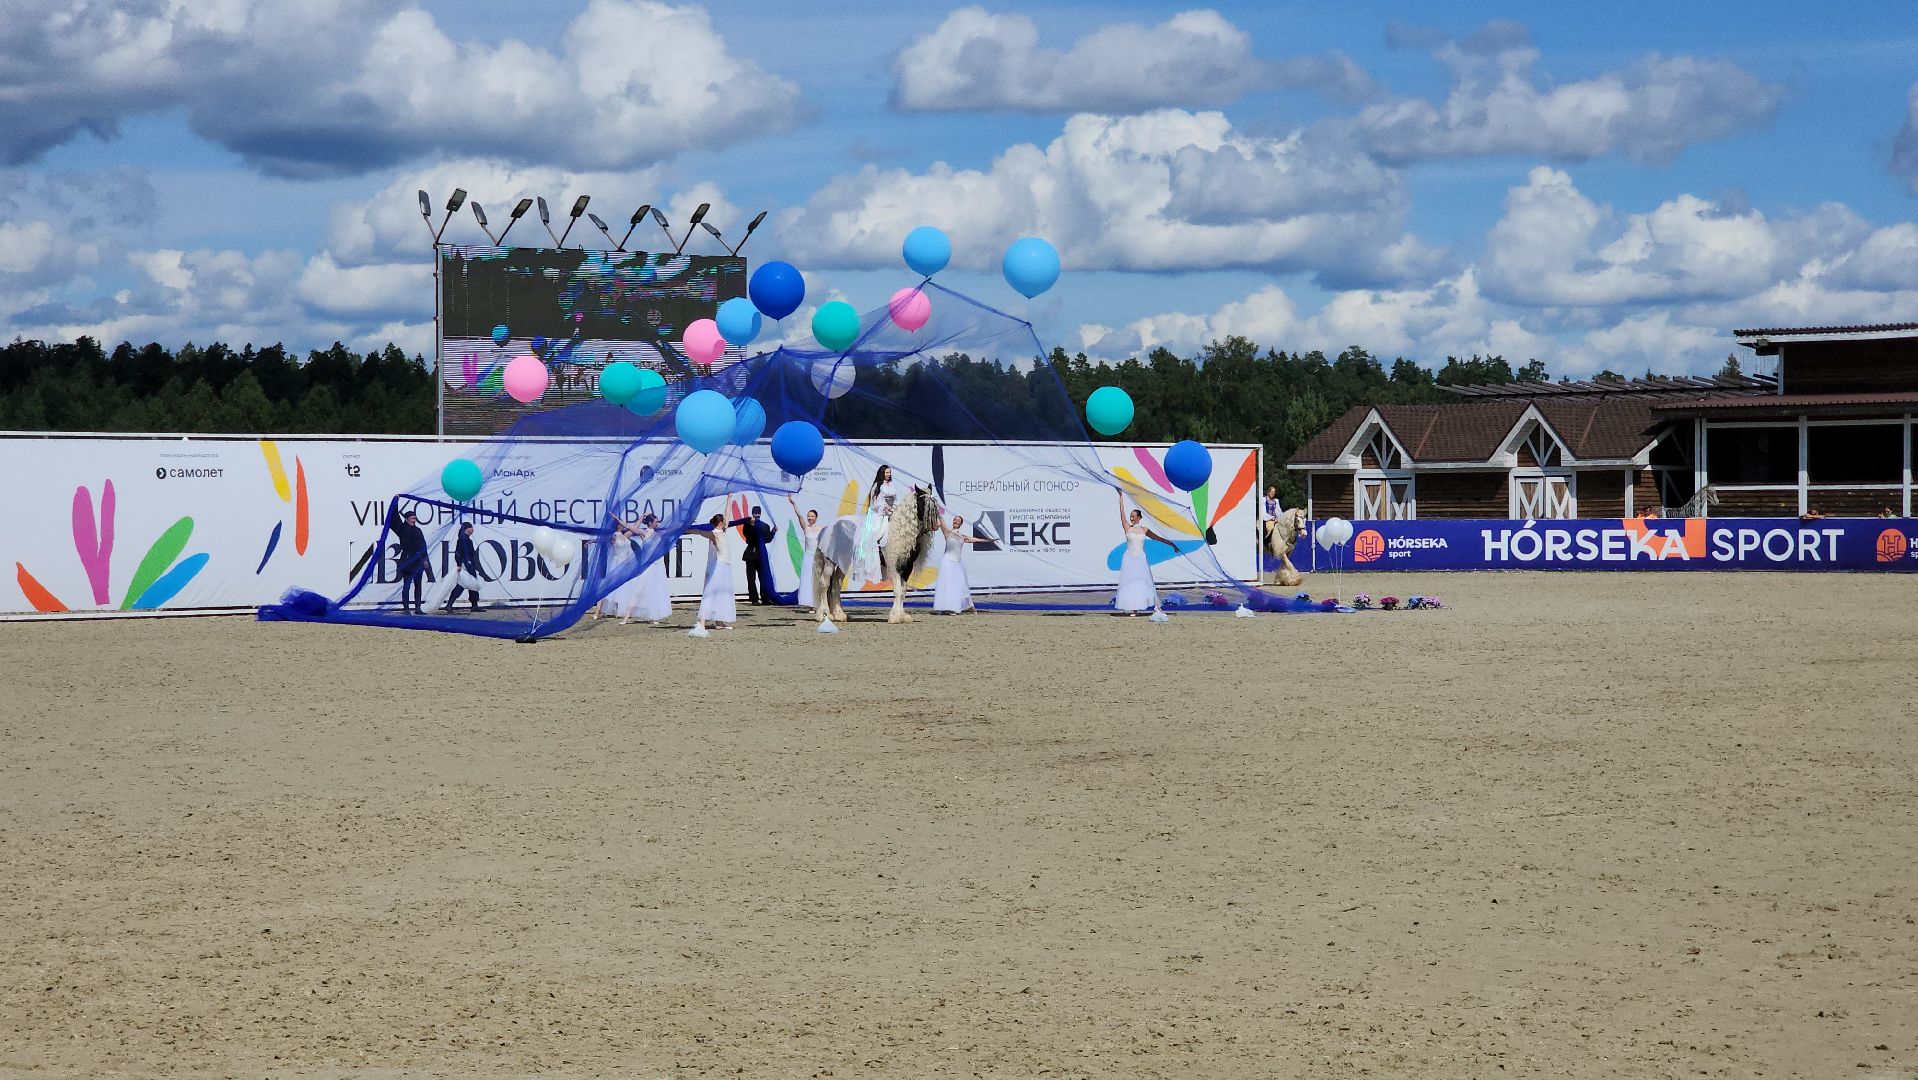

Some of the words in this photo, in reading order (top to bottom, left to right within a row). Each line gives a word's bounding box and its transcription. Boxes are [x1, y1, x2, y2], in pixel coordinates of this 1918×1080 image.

[169, 468, 224, 478] самолет
[344, 463, 361, 478] t2
[493, 468, 536, 479] МонАрх
[959, 479, 1030, 492] ГЕНЕРАЛЬНЫЙ
[1009, 522, 1071, 546] ЕКС
[1711, 528, 1845, 562] SPORT
[1388, 551, 1412, 559] sport
